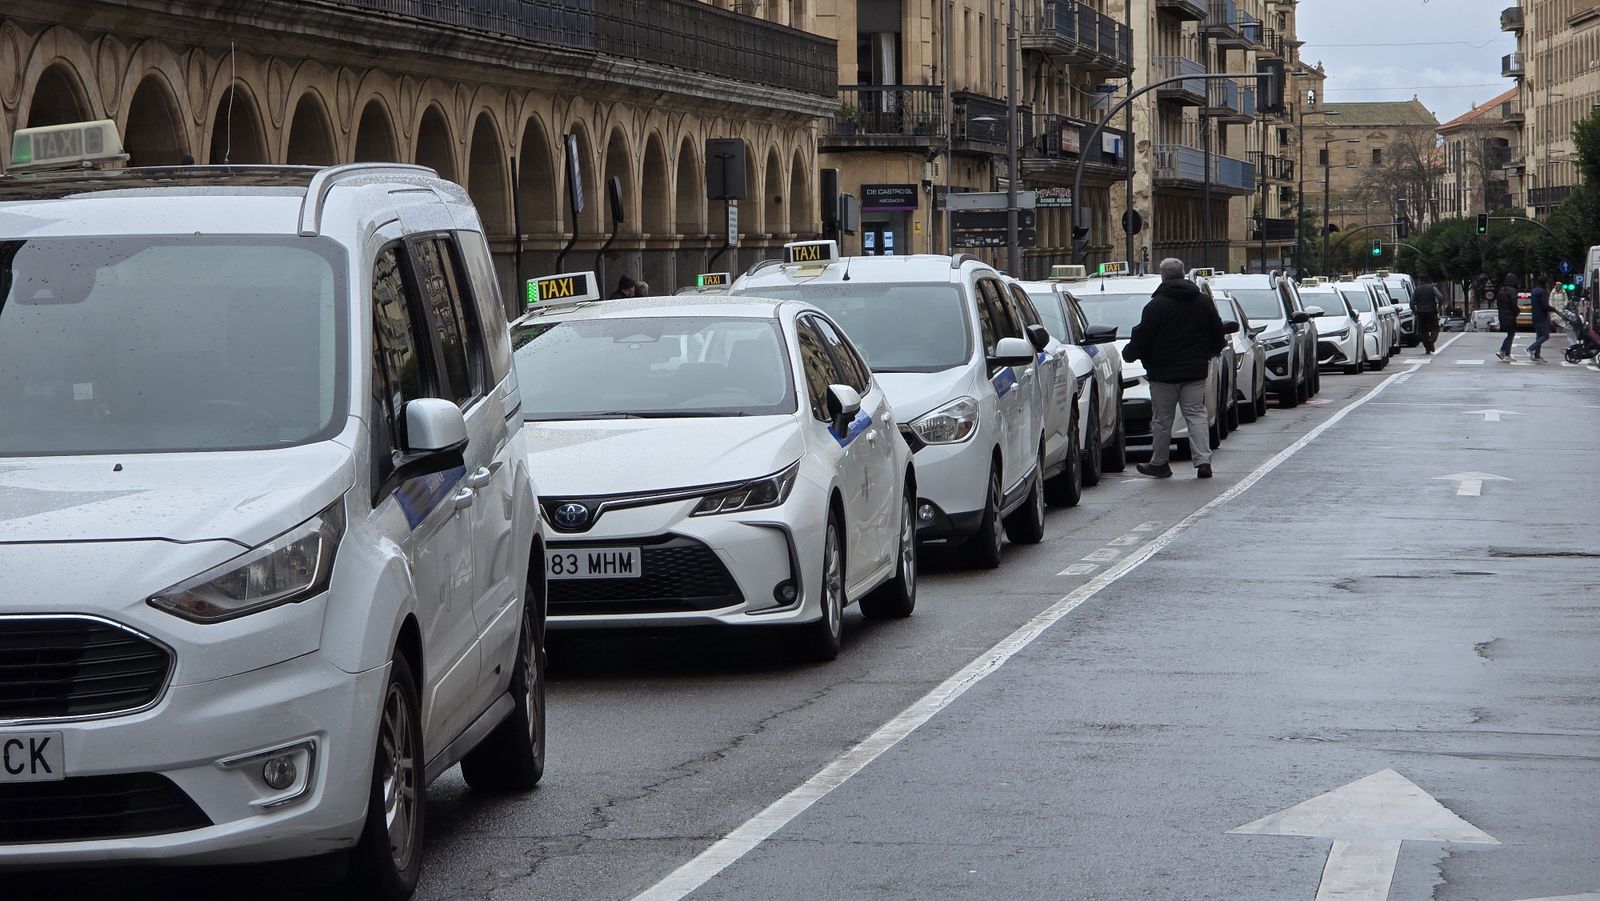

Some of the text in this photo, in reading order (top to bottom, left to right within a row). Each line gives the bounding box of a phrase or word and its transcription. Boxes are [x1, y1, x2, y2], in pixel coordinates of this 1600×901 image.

[36, 130, 80, 159] TAXI
[793, 245, 821, 261] TAXI
[1105, 264, 1121, 273] TAXI
[538, 277, 575, 299] TAXI
[703, 275, 721, 285] TAXI
[546, 551, 633, 575] 83 MHM
[3, 736, 53, 775] CK
